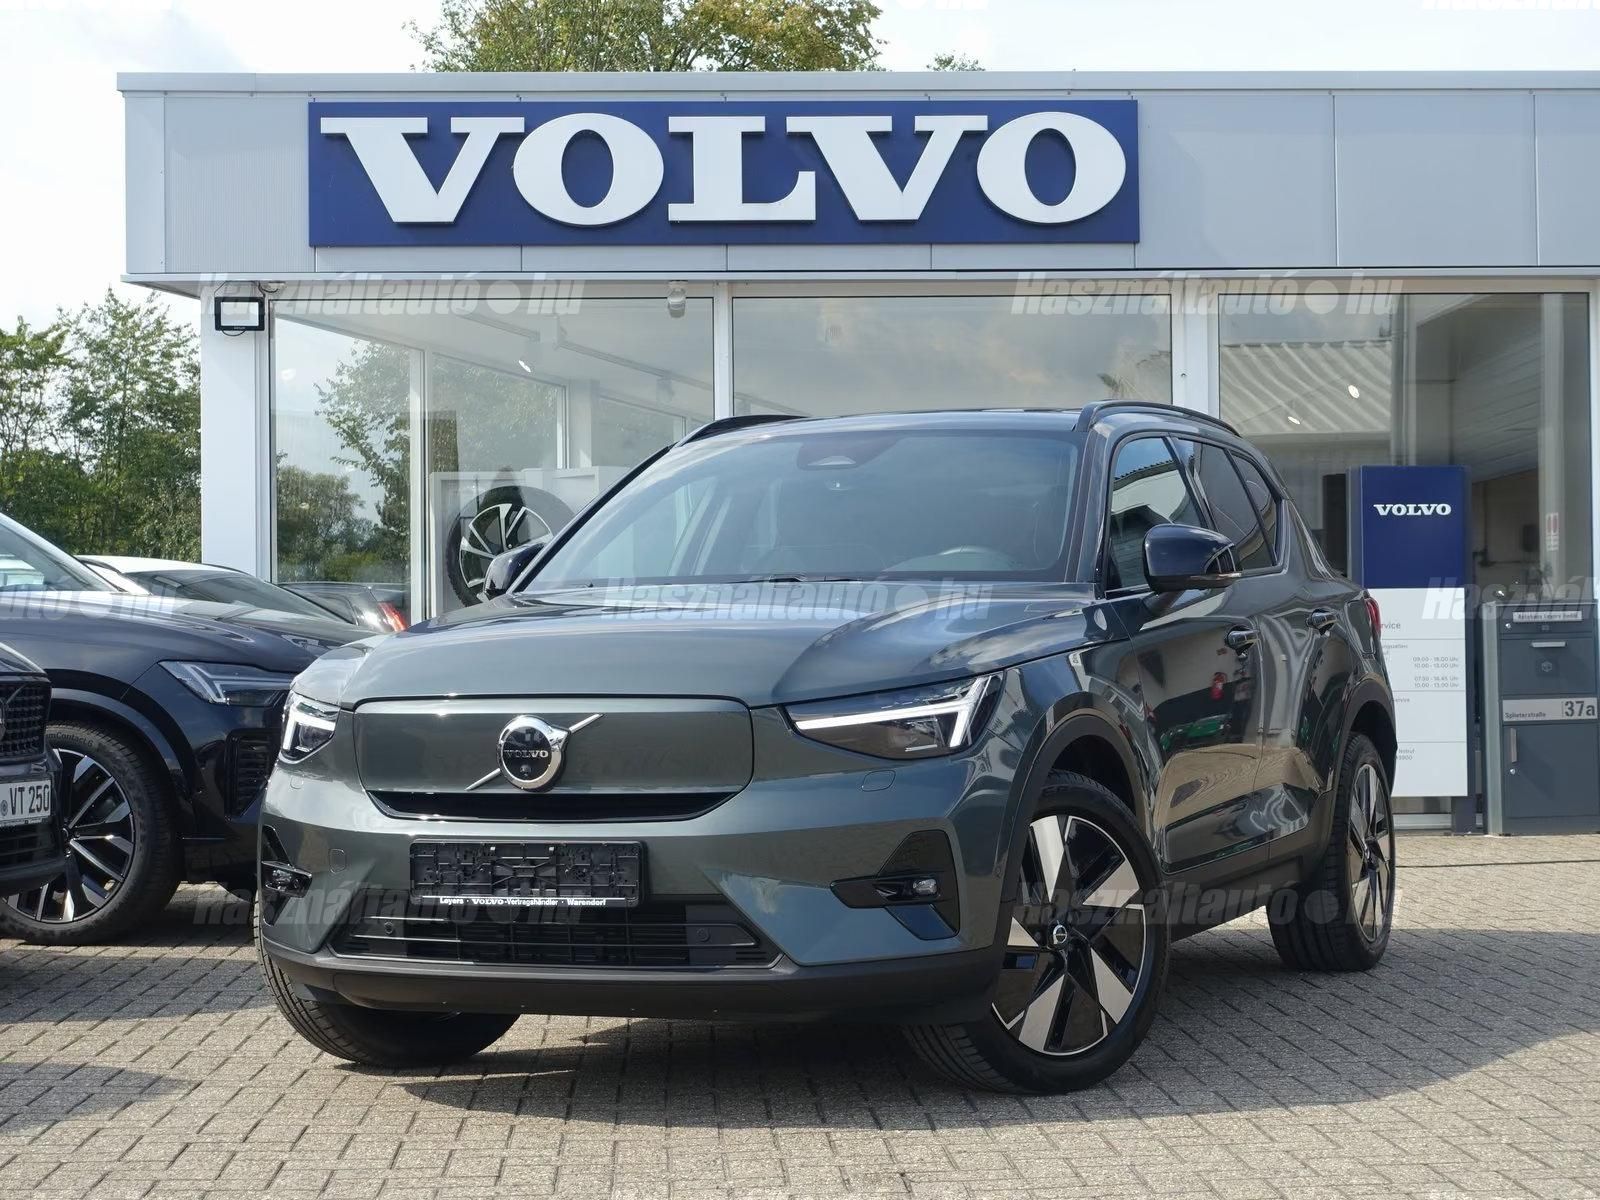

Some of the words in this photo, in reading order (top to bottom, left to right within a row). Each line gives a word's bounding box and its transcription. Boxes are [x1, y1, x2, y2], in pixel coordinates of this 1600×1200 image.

[320, 112, 1127, 226] VOLVO
[1373, 503, 1452, 516] VOLVO
[1380, 622, 1401, 630] rvice
[1564, 700, 1596, 717] 37a
[503, 749, 549, 758] VOLVO
[9, 786, 25, 816] VT
[28, 784, 50, 814] 250
[566, 898, 607, 906] Warendorf
